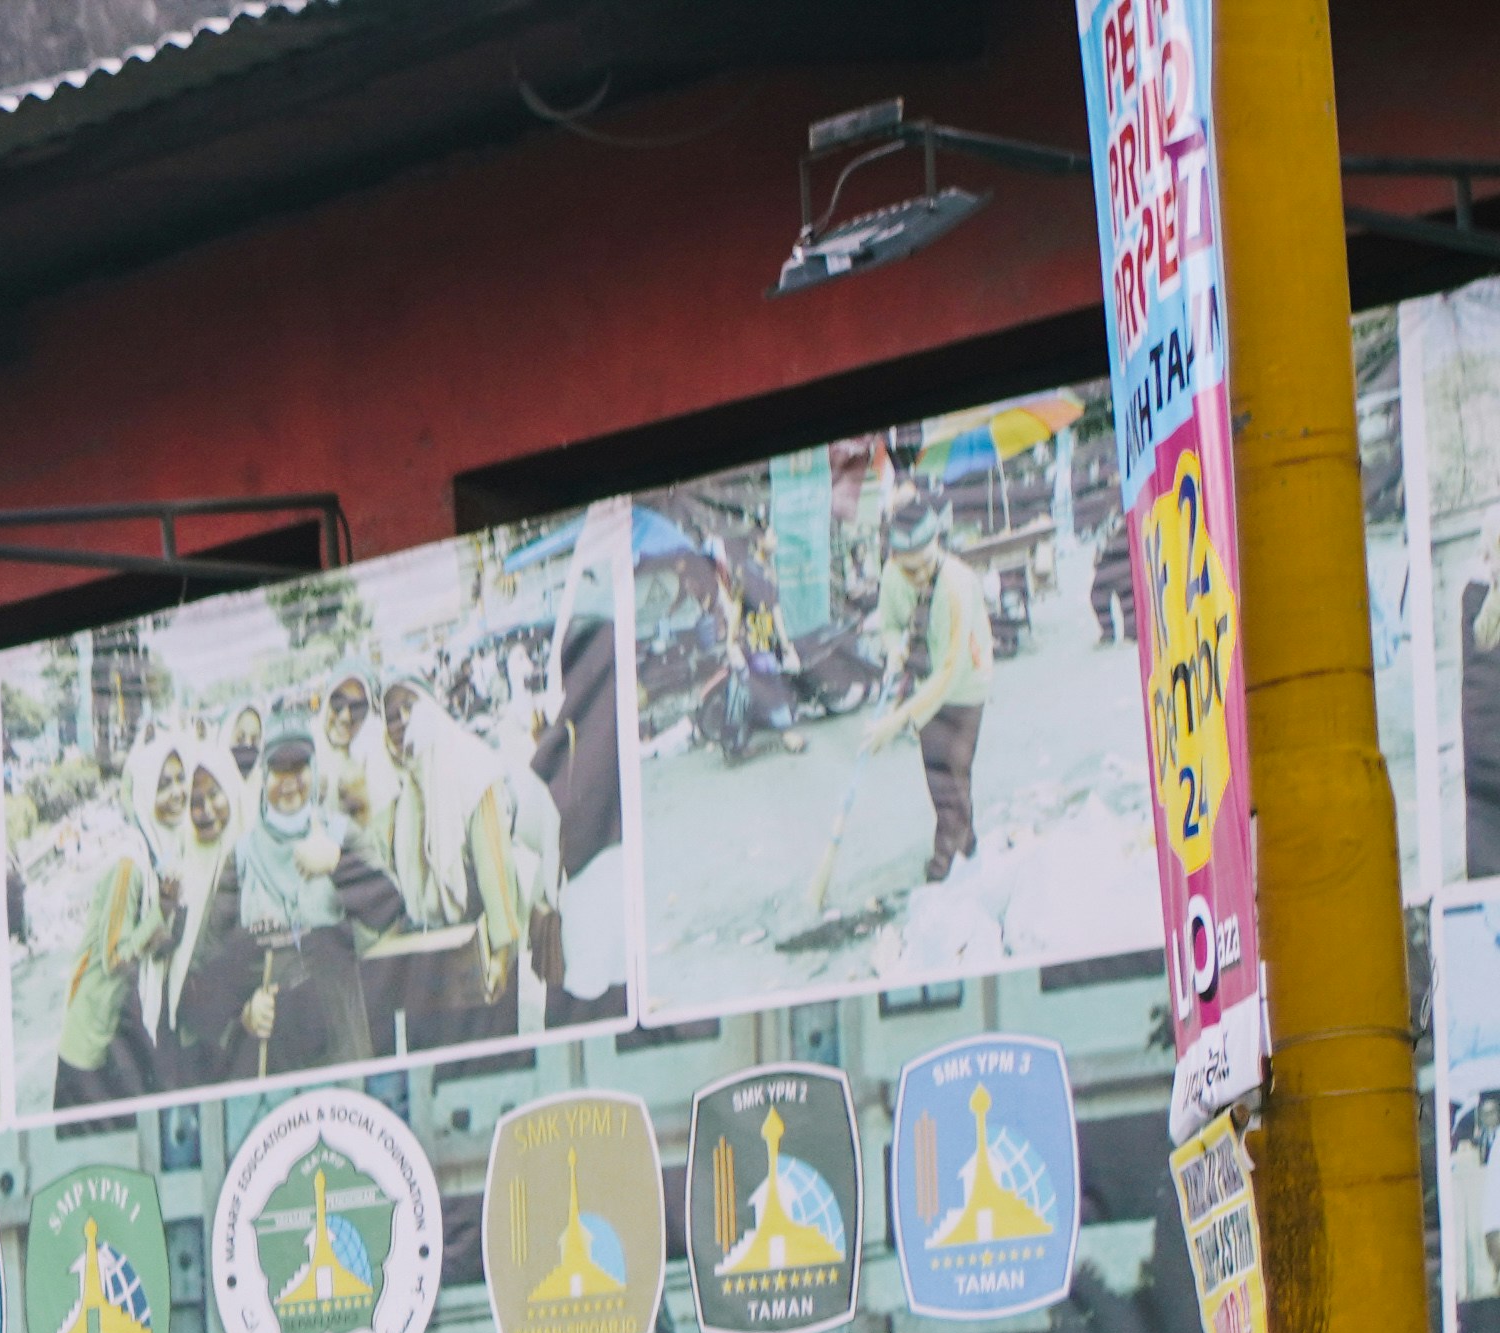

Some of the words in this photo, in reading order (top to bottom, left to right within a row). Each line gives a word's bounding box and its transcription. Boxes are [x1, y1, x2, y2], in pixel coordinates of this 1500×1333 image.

[932, 1057, 971, 1087] SMK
[973, 1052, 1015, 1081] YPM
[1017, 1050, 1031, 1077] 3
[732, 1087, 767, 1114] SMK
[768, 1083, 797, 1109] YPM
[513, 1116, 561, 1155] SMK
[563, 1105, 616, 1141] YPM
[619, 1104, 631, 1139] 1
[238, 1108, 312, 1192] EDUCATIONAL
[329, 1105, 376, 1138] SOCIAL
[377, 1128, 427, 1232] FOUNDATION
[86, 1173, 127, 1209] YPM
[954, 1270, 1026, 1297] TAMAN
[747, 1295, 815, 1323] TAMAN
